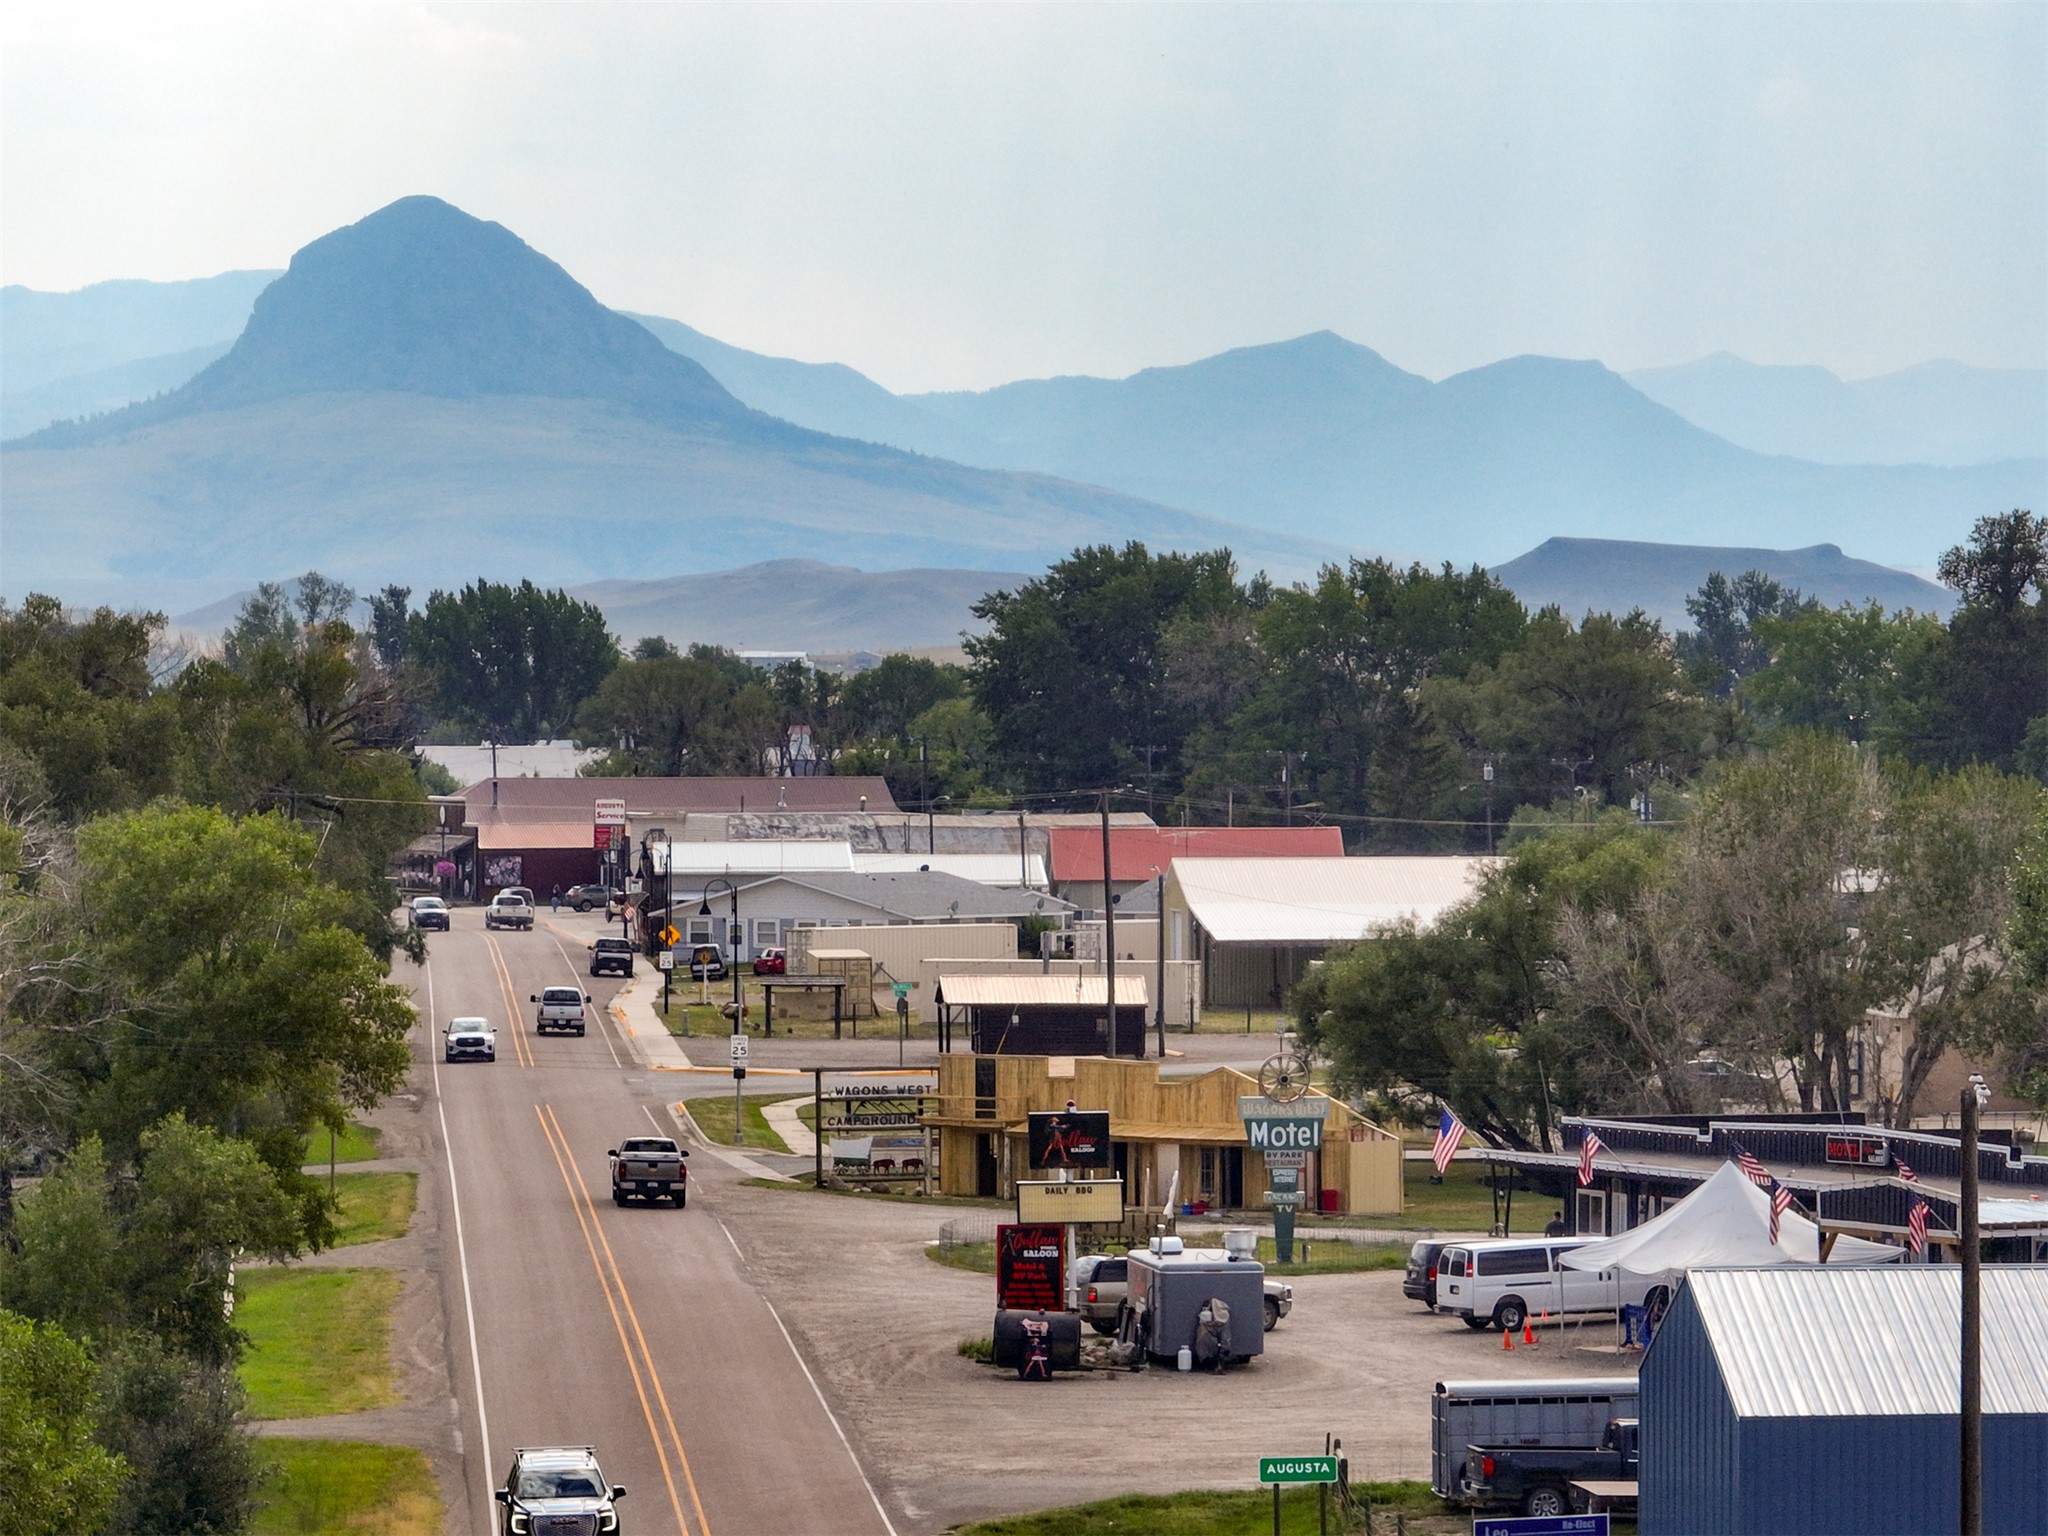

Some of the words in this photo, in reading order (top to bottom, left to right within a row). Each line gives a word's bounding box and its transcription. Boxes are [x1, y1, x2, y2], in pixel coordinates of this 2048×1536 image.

[596, 811, 624, 819] Service
[661, 959, 672, 967] 25
[732, 1046, 747, 1055] 25
[835, 1085, 889, 1096] WAGONS
[896, 1085, 932, 1095] WEST
[1243, 1102, 1293, 1116] WAGONS
[1295, 1101, 1328, 1116] WEST
[827, 1115, 916, 1126] CAMPGROUND
[1251, 1121, 1319, 1147] Motel
[1828, 1142, 1860, 1158] MOTEL
[1045, 1187, 1068, 1195] DAILY
[1076, 1186, 1093, 1194] BBQ
[1276, 1204, 1294, 1213] TV
[1013, 1229, 1058, 1250] Outlaw
[1023, 1249, 1059, 1258] SALOON
[1266, 1462, 1330, 1474] AUGUSTA
[1562, 1519, 1596, 1530] Re-Elect
